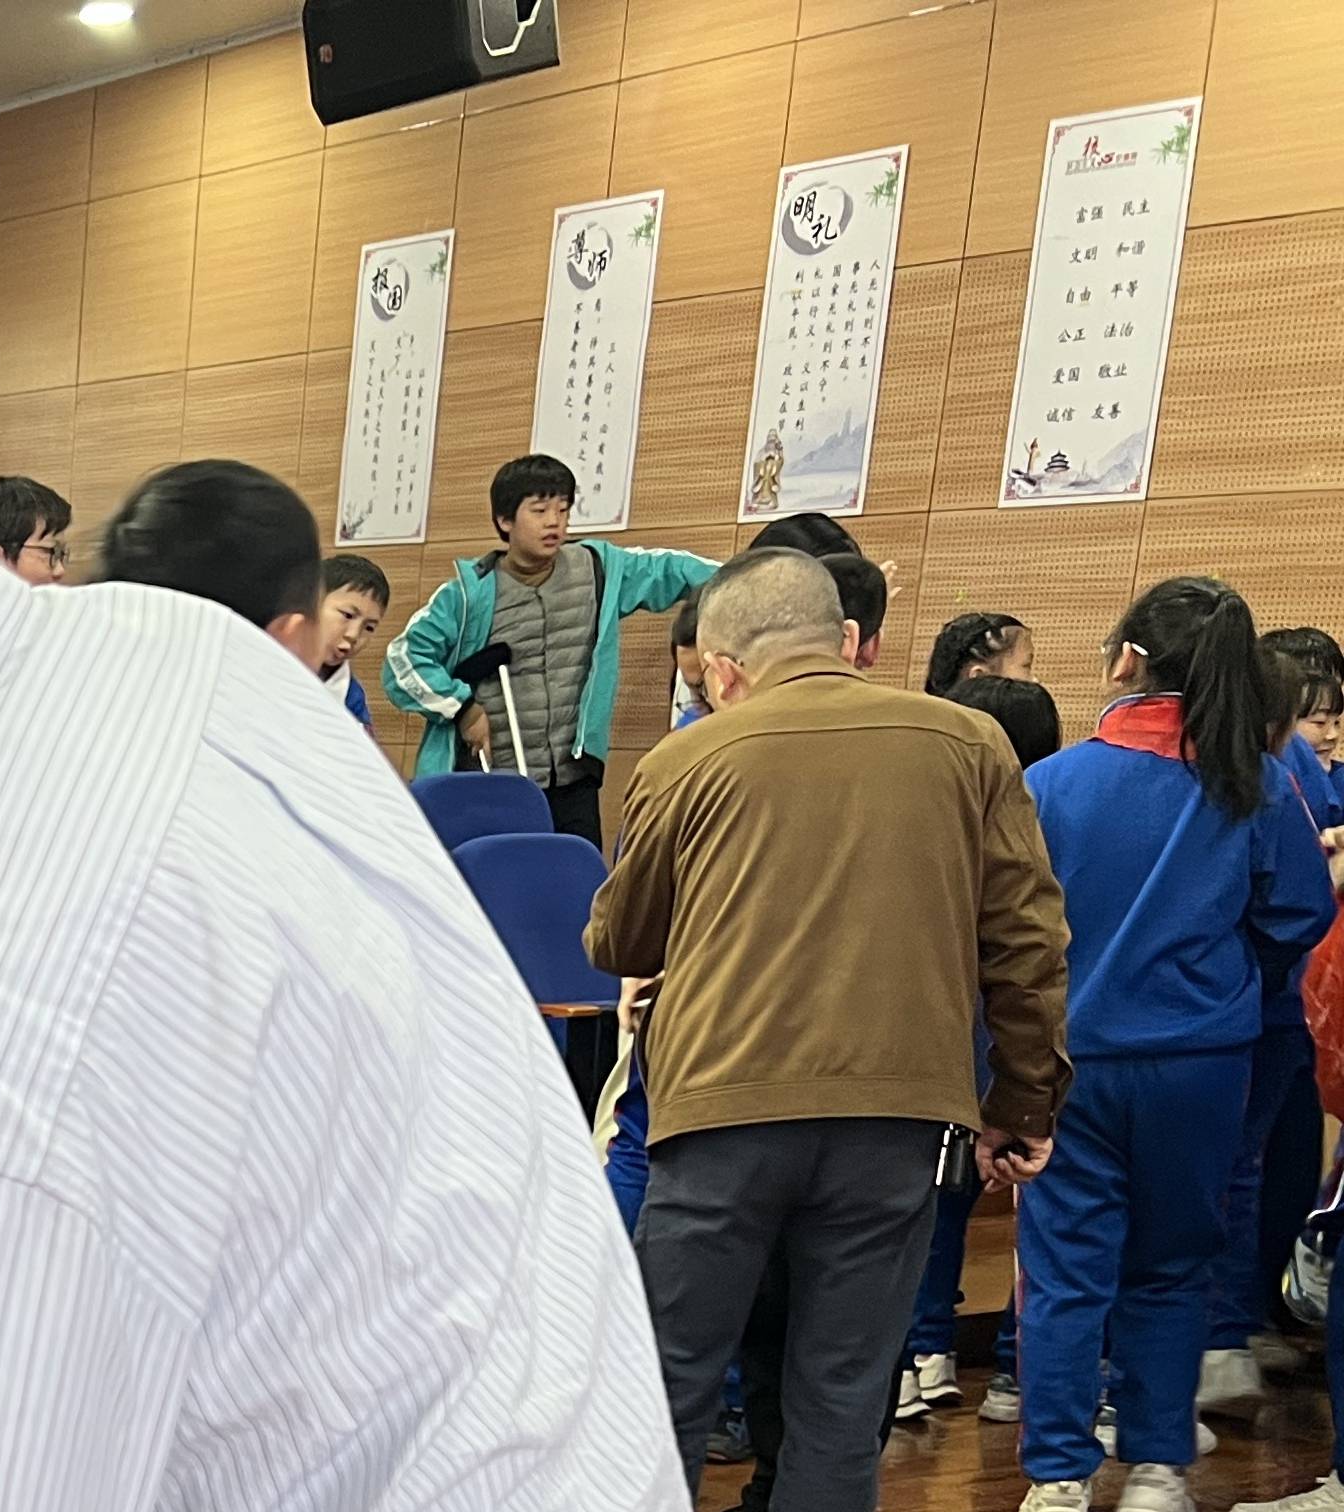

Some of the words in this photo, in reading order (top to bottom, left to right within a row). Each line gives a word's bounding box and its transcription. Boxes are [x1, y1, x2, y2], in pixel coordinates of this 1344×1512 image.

[793, 190, 838, 244] 明礼
[1076, 205, 1104, 223] 富强
[1122, 198, 1150, 216] 民主
[567, 229, 608, 282] 尊师
[1069, 246, 1098, 263] 文明
[1117, 240, 1145, 257] 和谐
[371, 267, 403, 312] 报国
[1066, 286, 1092, 304] 自由
[1111, 280, 1138, 298] 平等
[1057, 328, 1086, 343] 公正
[1104, 321, 1133, 338] 法治
[1052, 366, 1080, 384] 爱国
[1098, 363, 1127, 378] 敬业
[1046, 407, 1076, 422] 诚信
[1091, 401, 1121, 419] 友善
